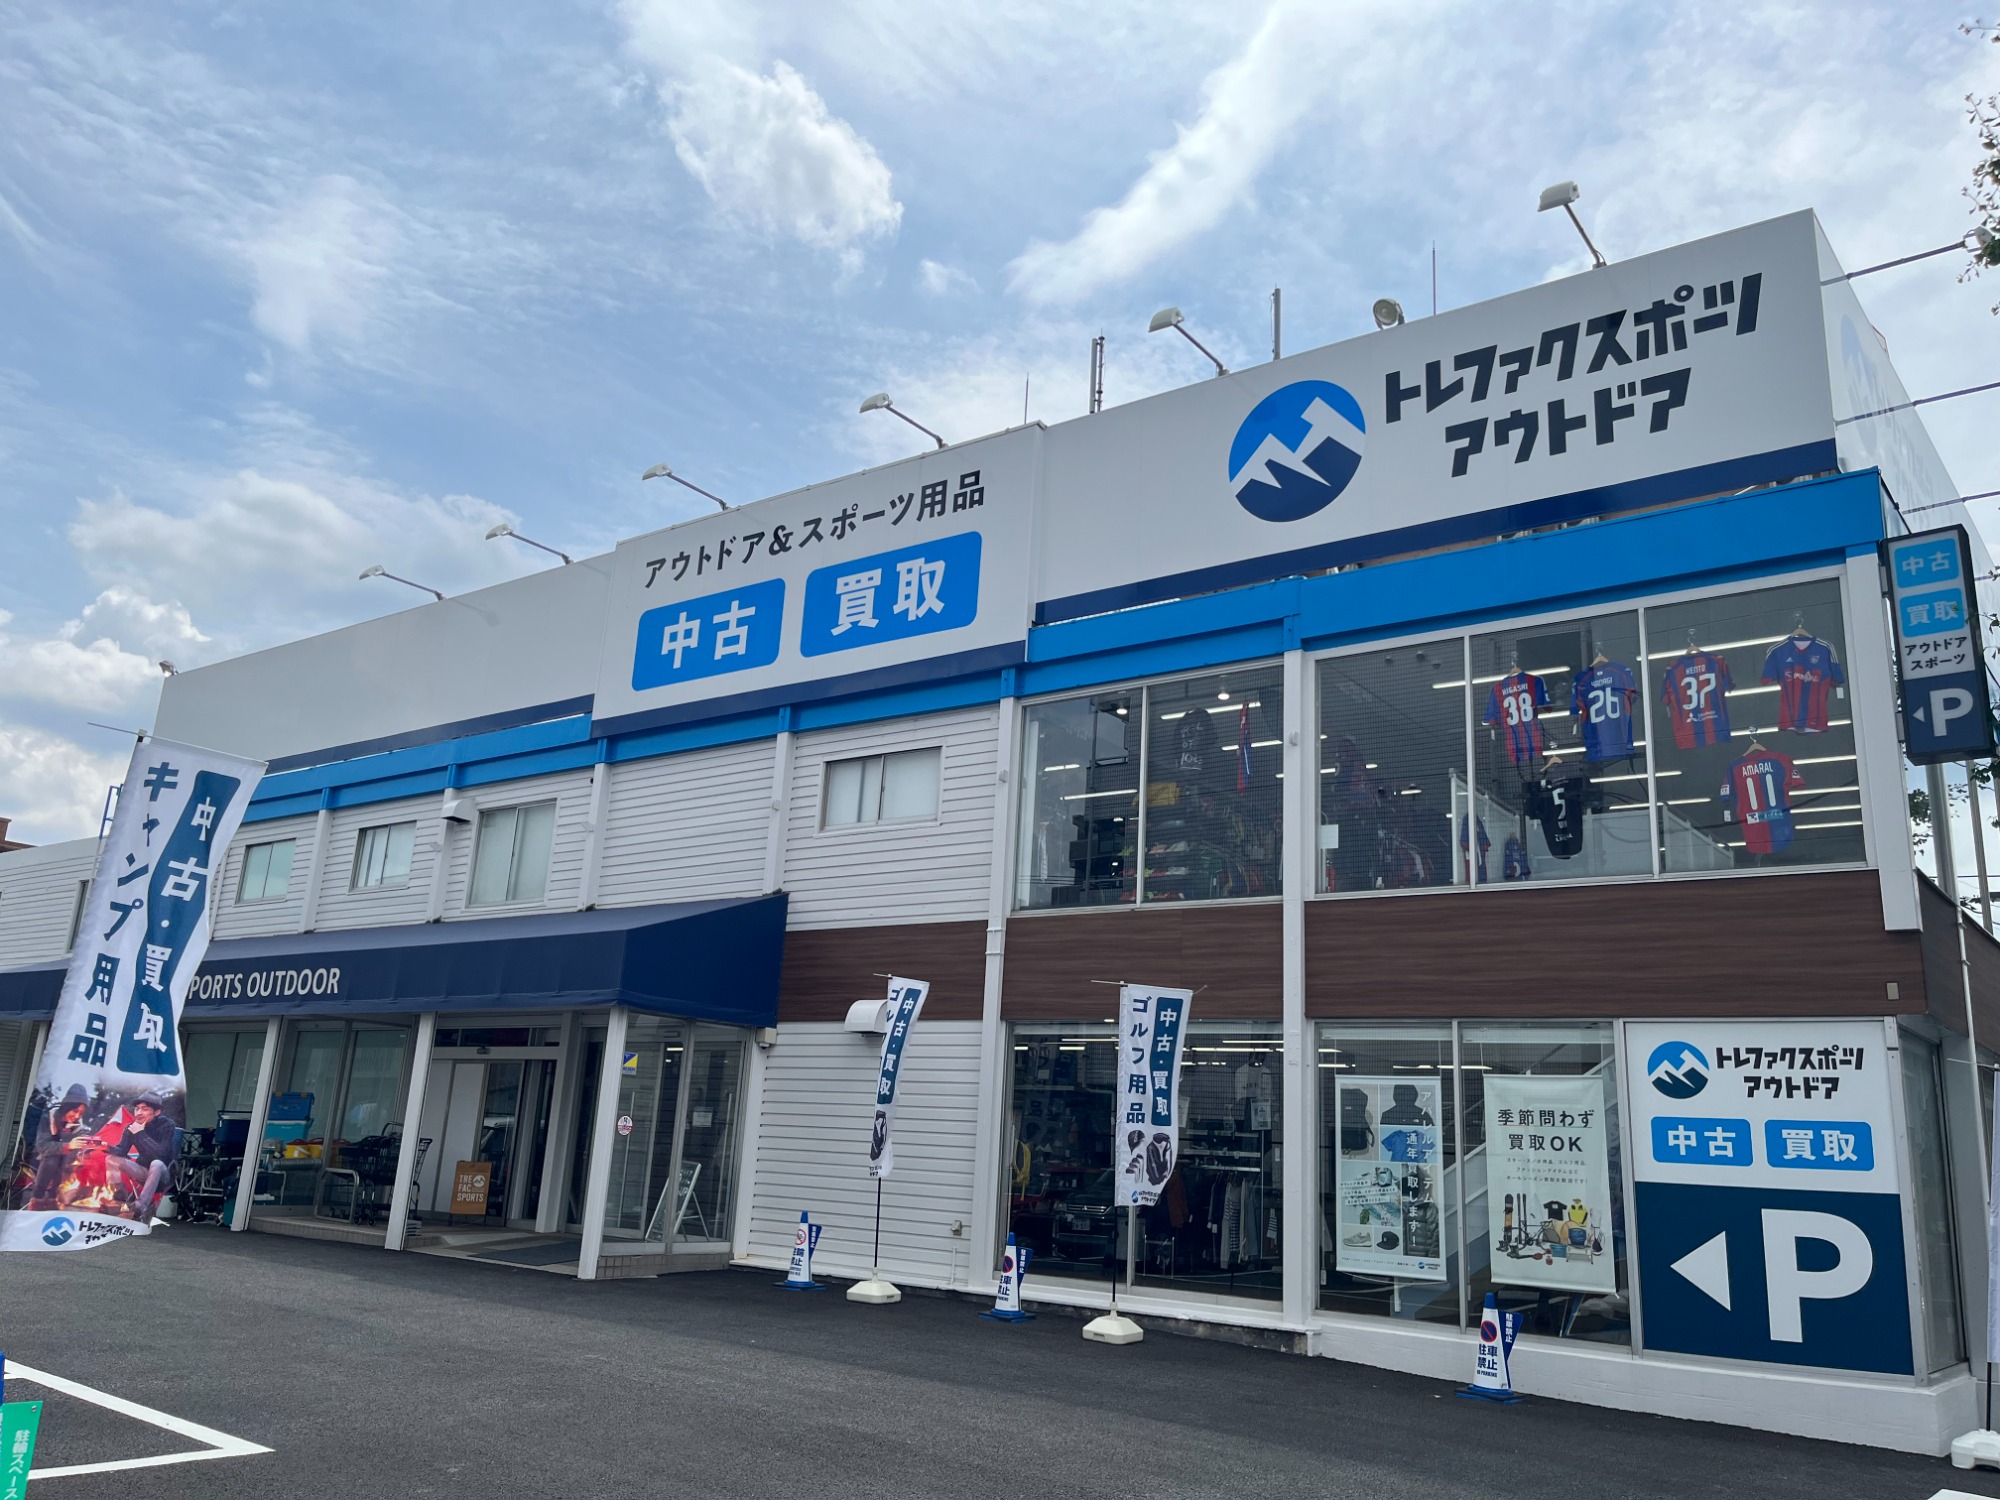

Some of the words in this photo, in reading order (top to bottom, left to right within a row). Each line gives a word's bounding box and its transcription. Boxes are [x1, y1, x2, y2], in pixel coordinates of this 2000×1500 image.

[1386, 272, 1762, 423] トレファクスポーツ
[1445, 368, 1691, 477] アウトドア
[644, 470, 985, 588] アウトドア&スポーツ用品
[1901, 551, 1950, 576] 中古
[830, 556, 946, 636] 買取
[1906, 600, 1959, 627] 買取
[661, 600, 756, 669] 中古
[1904, 636, 1968, 656] アウトドア
[1910, 653, 1966, 671] スポーツ
[1501, 683, 1528, 696] HIGASHI
[1588, 686, 1621, 724] 26
[1680, 673, 1716, 710] 37
[1503, 692, 1534, 726] 38
[1929, 687, 1974, 737] P
[1742, 761, 1774, 777] AMARAL
[1552, 787, 1567, 820] 5
[1746, 774, 1777, 810] 11
[68, 761, 179, 1067] キャンプ用品
[133, 796, 218, 1053] 中古・買取
[188, 973, 243, 999] PORTS
[246, 967, 341, 998] OUTDOOR
[879, 997, 915, 1096] 中古・買取
[1126, 996, 1153, 1124] ゴルフ用品
[1152, 1008, 1177, 1116] 中古・買取
[1715, 1045, 1864, 1071] トレファクスポーツ
[1744, 1076, 1840, 1099] アウトドア
[1498, 1108, 1595, 1128] 季節問わず
[1508, 1134, 1583, 1152] 買取OK
[1667, 1125, 1736, 1158] 中古
[1781, 1129, 1858, 1162] 買取
[458, 1184, 472, 1193] FAC
[459, 1175, 473, 1184] TRE
[457, 1193, 484, 1202] SPORTS
[1761, 1208, 1873, 1343] P
[1505, 1313, 1513, 1343] 駐車禁止
[1477, 1357, 1498, 1370] 禁止
[1479, 1344, 1497, 1357] 駐車
